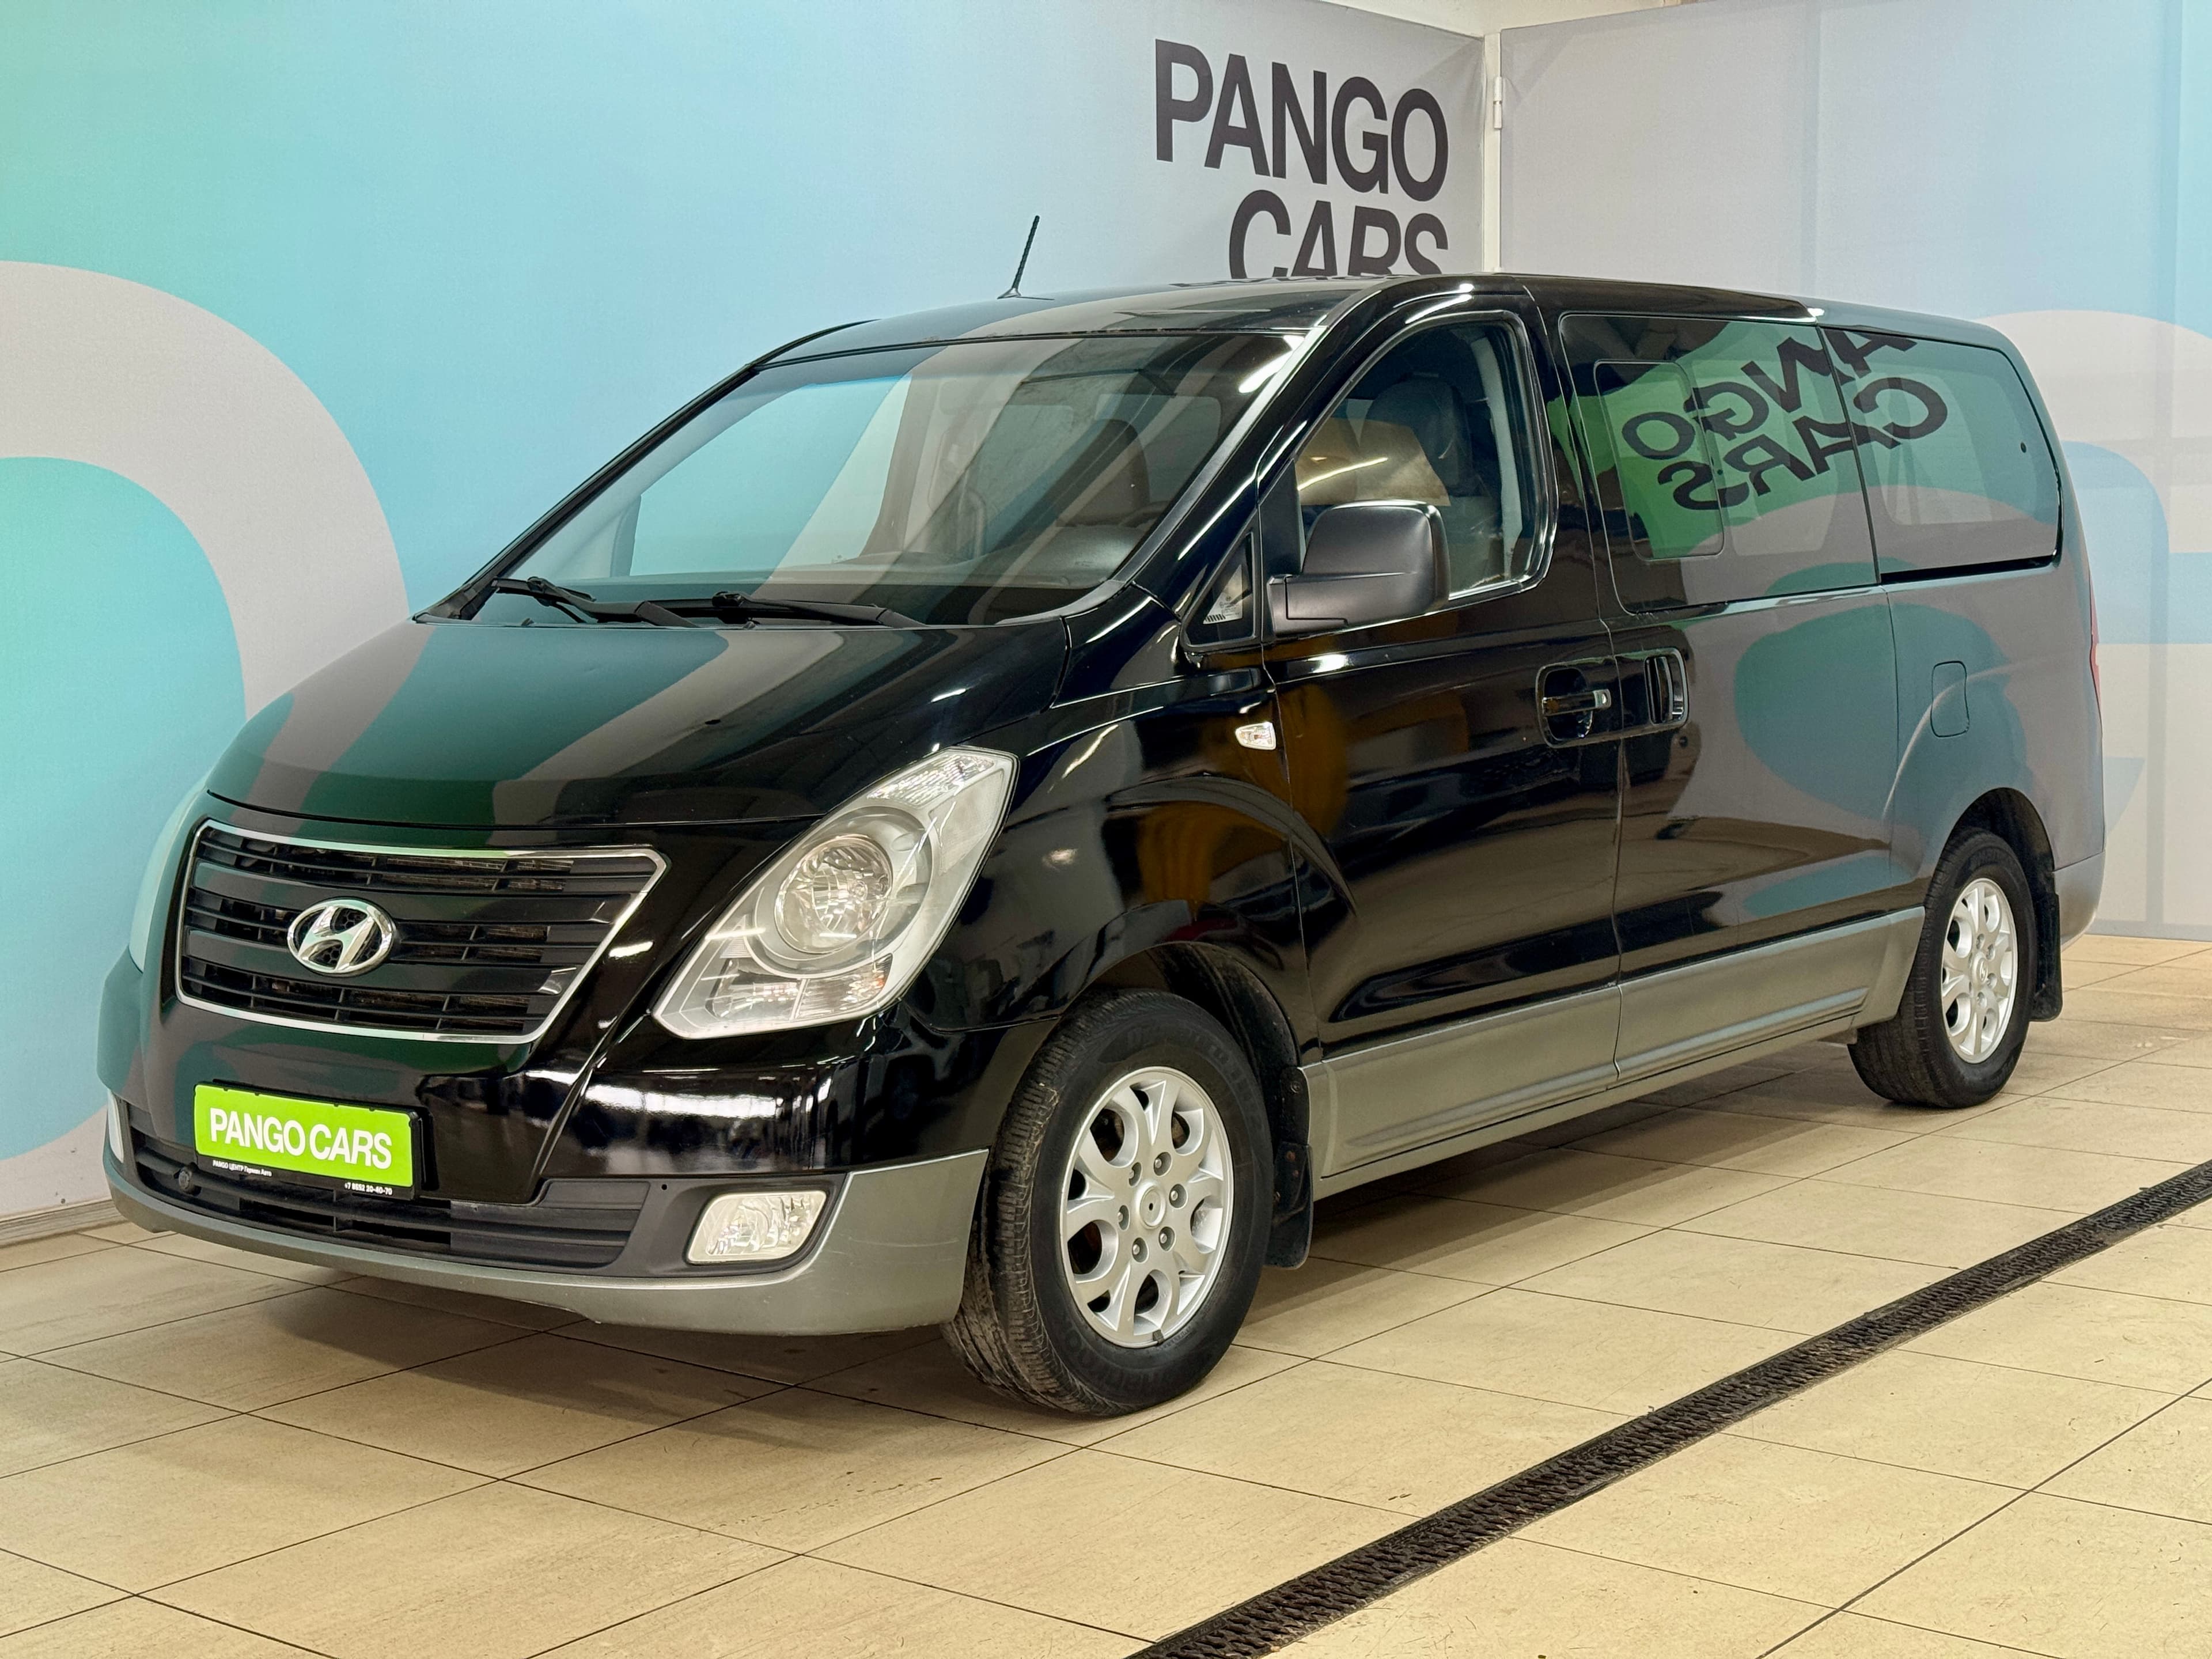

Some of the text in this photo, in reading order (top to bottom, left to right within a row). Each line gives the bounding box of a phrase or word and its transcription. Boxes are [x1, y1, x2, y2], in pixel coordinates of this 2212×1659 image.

[1156, 39, 1449, 202] PANGO
[1229, 190, 1449, 279] CARS
[210, 1107, 392, 1169] PANGO CARS
[213, 1160, 229, 1169] PANGO
[344, 1181, 351, 1190] +7
[366, 1184, 393, 1195] 20-40-70
